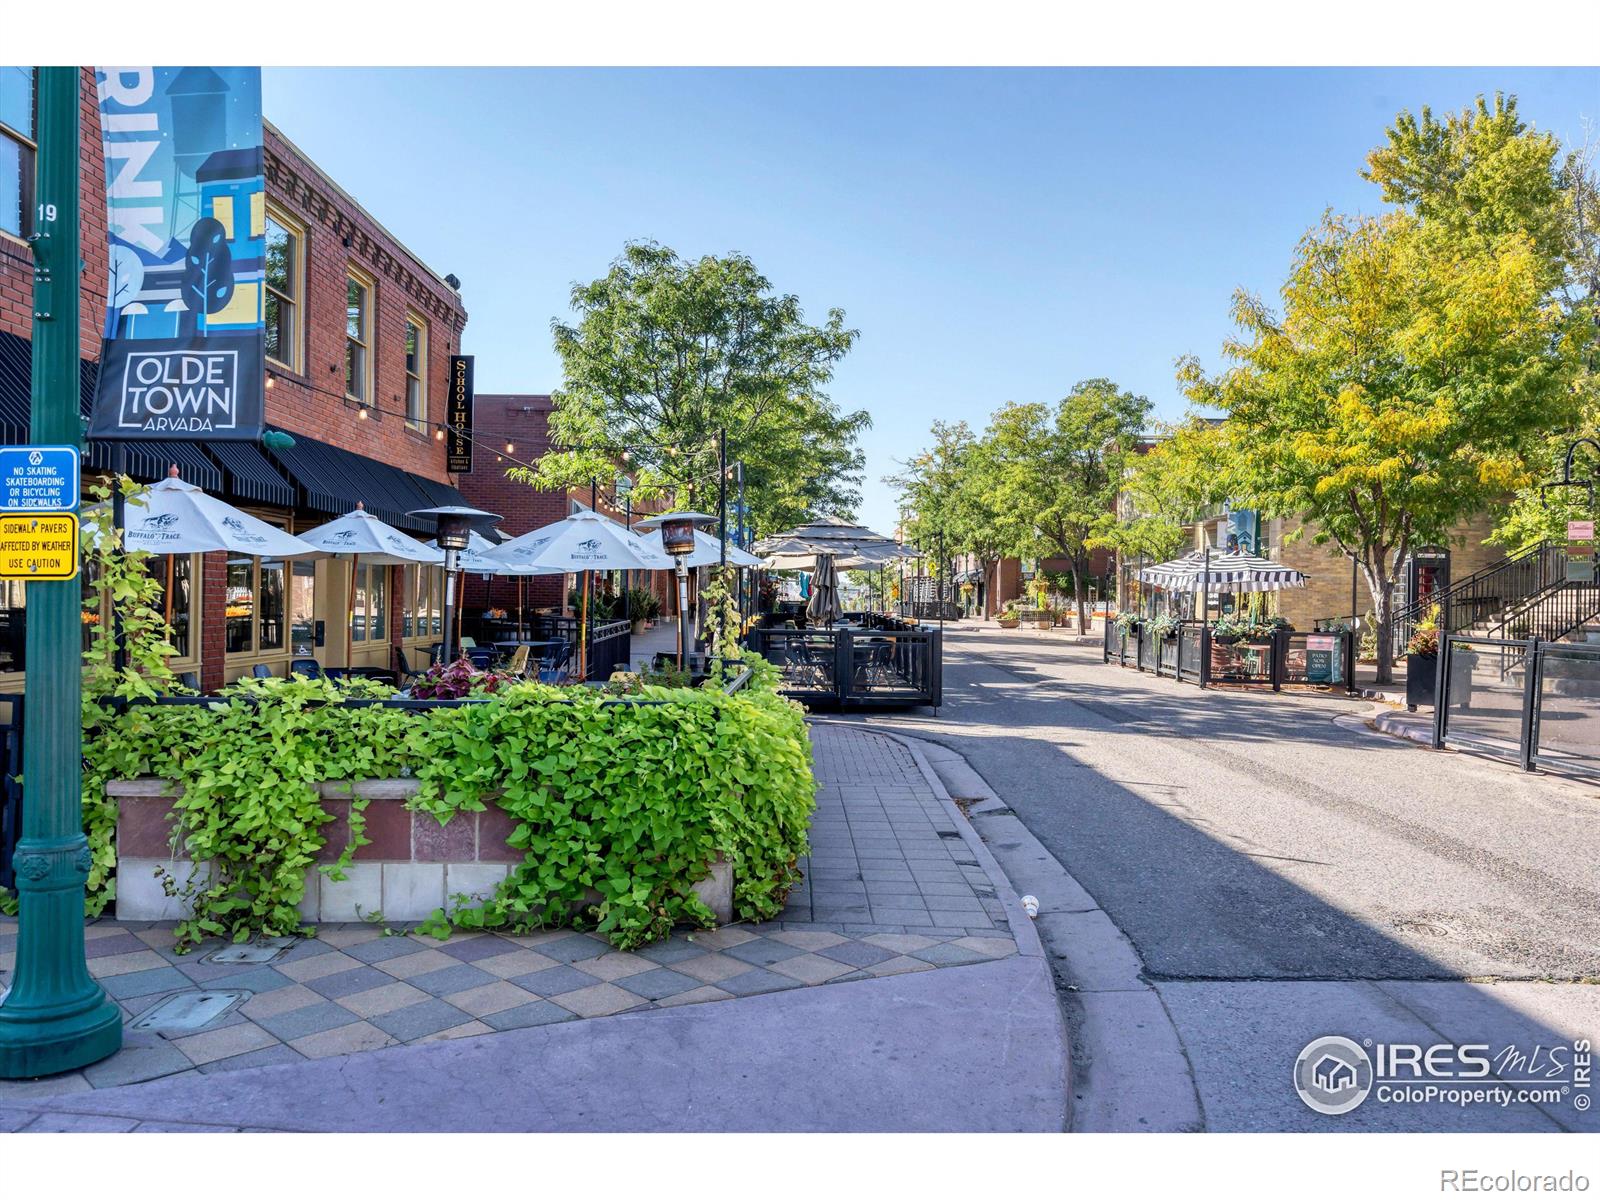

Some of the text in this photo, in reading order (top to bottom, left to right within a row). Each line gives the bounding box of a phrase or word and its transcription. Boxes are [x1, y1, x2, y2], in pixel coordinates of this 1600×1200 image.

[38, 204, 57, 221] 19
[136, 357, 225, 385] OLDE
[456, 360, 466, 409] SCHOOL
[128, 387, 230, 415] TOWN
[142, 417, 213, 432] ARVADA
[13, 466, 57, 476] NO SKATING
[5, 477, 65, 486] SKATEBOARDING
[9, 487, 61, 497] OR BICYCLING
[8, 498, 62, 507] ON SIDEWALKS
[3, 523, 68, 534] SIDEWALK PAVERS
[127, 531, 182, 540] BUFFALO TRACE
[0, 541, 71, 551] AFFECTED BY WEATHER
[8, 558, 61, 568] USE CAUTION
